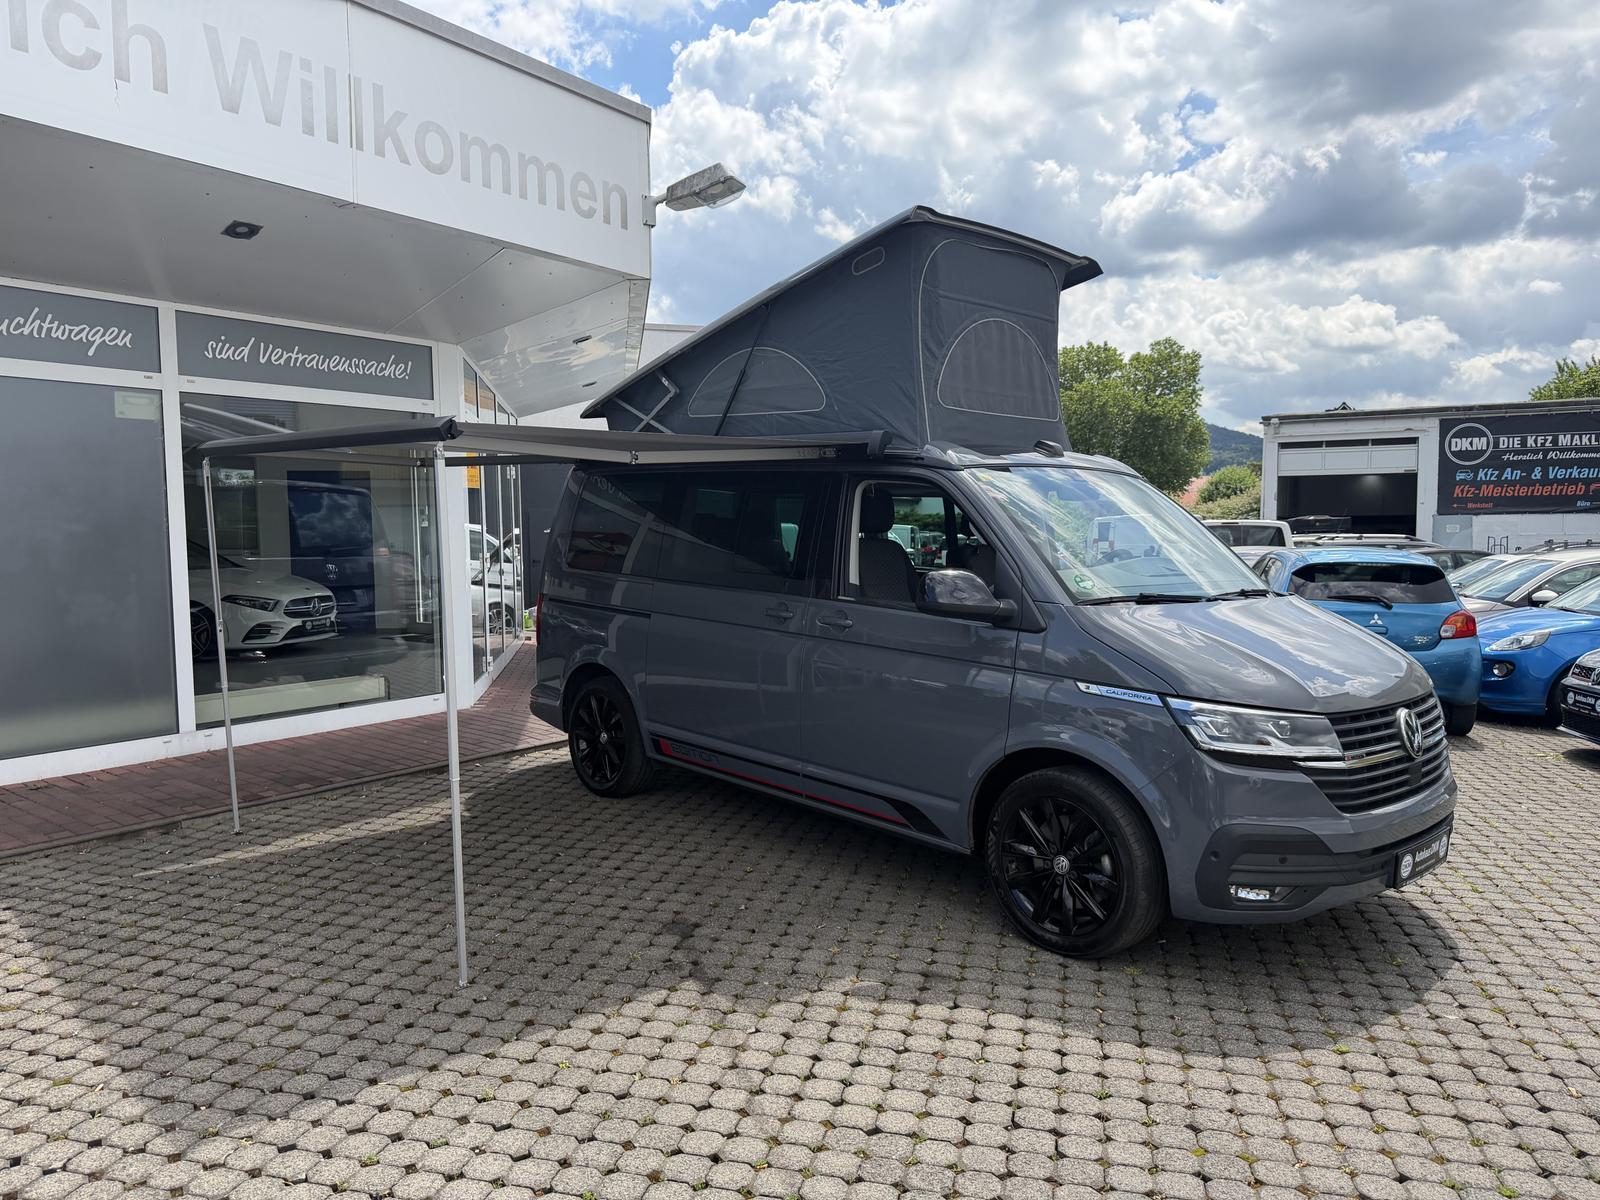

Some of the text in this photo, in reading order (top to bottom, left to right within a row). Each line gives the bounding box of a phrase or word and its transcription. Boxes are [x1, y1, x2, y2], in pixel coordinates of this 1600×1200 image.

[201, 22, 629, 231] Willkommen
[204, 336, 412, 380] sind Vertrauenssache!
[1451, 437, 1488, 451] DKM
[1499, 433, 1600, 449] DIE KFZ MAKL
[1501, 451, 1544, 461] Herzlich
[1477, 465, 1600, 481] Kfz An- & Verkau
[1453, 482, 1586, 498] Kfz-Meisterbetrieb
[1105, 689, 1153, 701] CALIFORNIA
